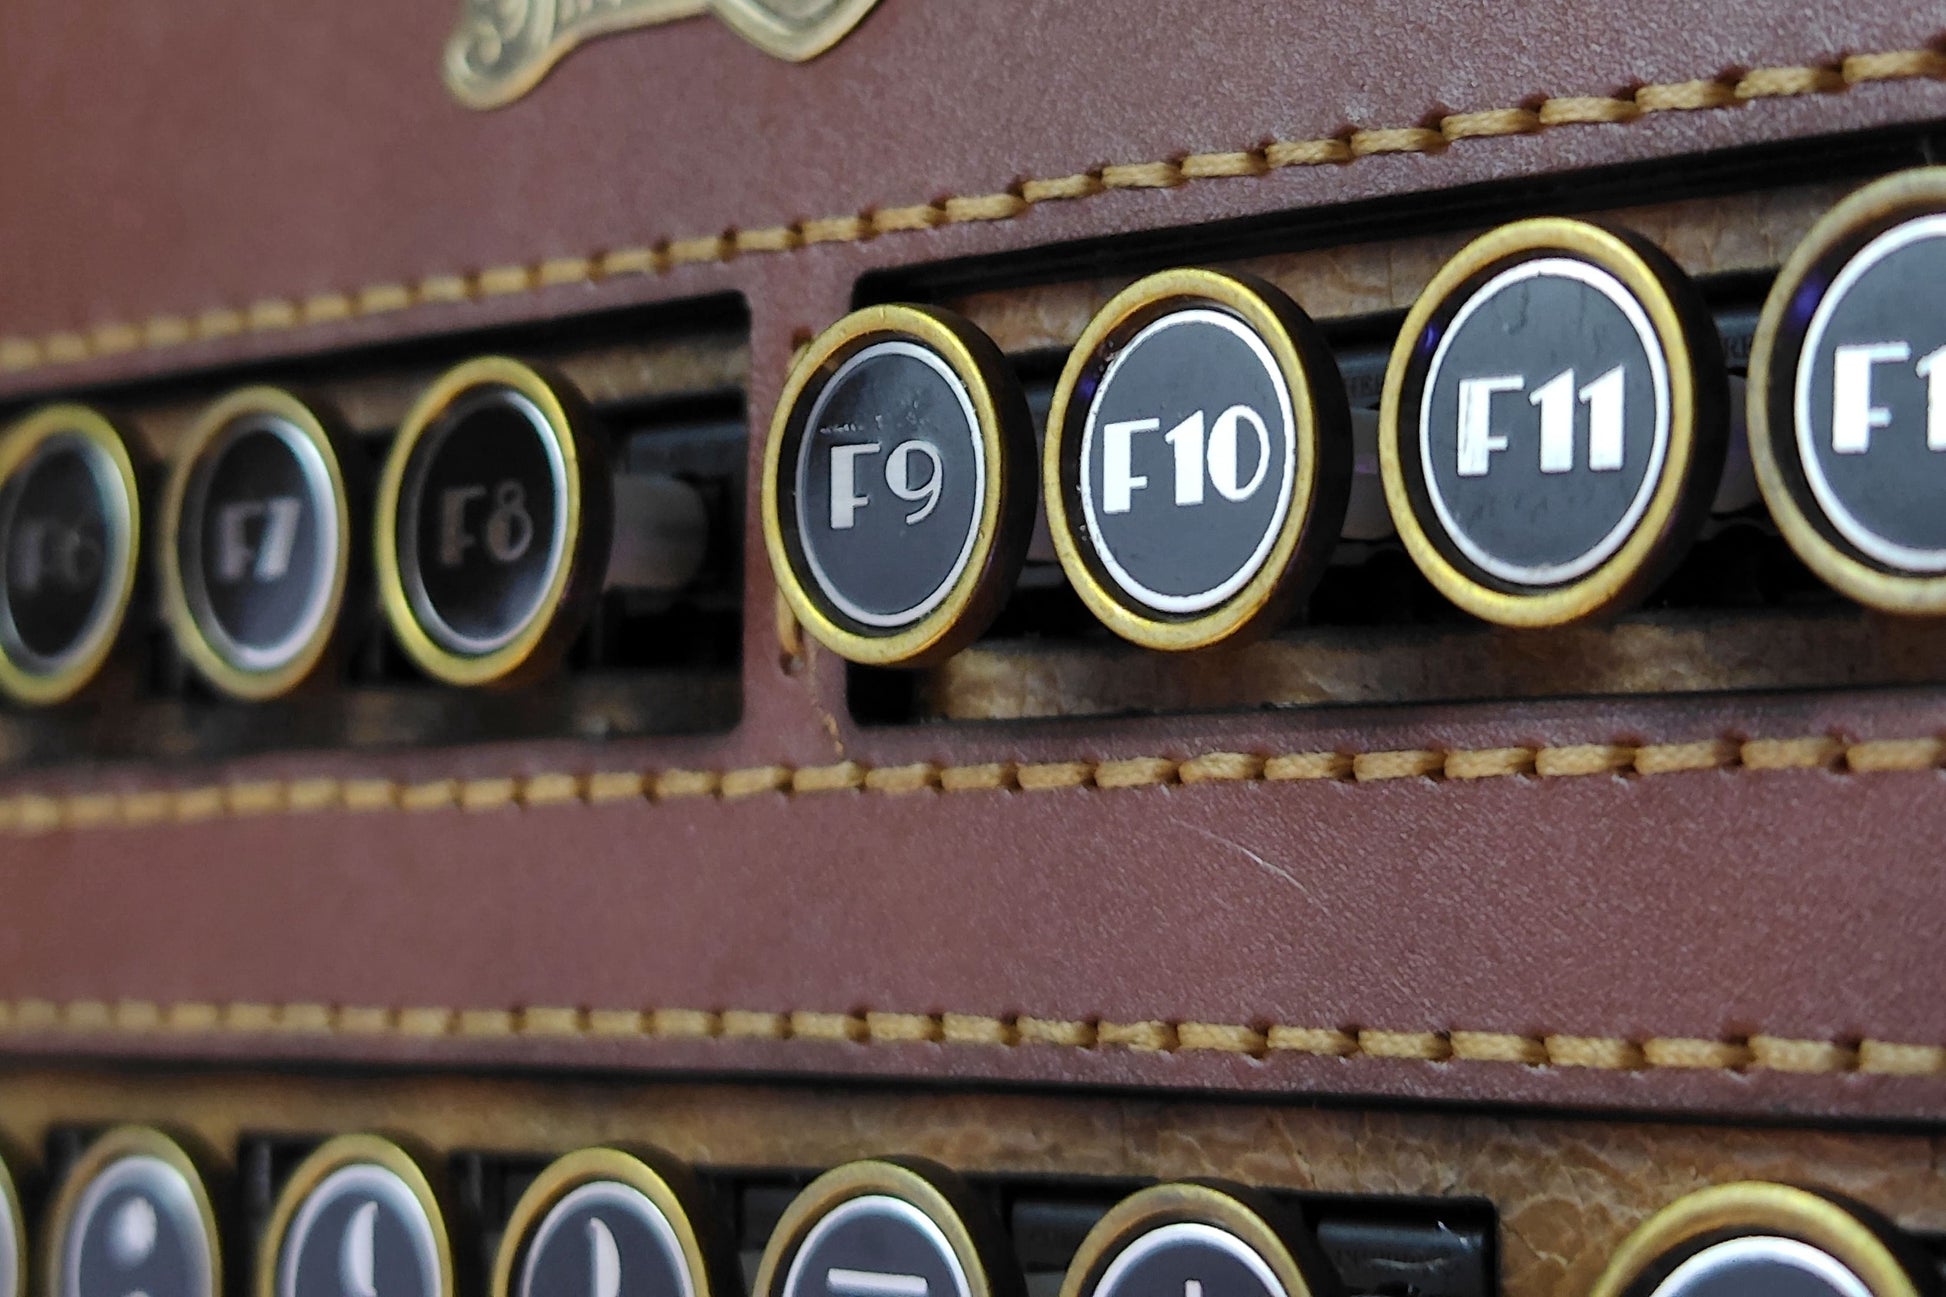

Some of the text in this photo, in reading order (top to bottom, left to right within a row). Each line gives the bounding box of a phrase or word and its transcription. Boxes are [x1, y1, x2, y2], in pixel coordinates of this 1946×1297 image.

[1102, 404, 1272, 515] F10
[1456, 364, 1626, 478] F11
[438, 481, 534, 567] F8
[829, 440, 944, 530] F9
[216, 497, 301, 582] F7
